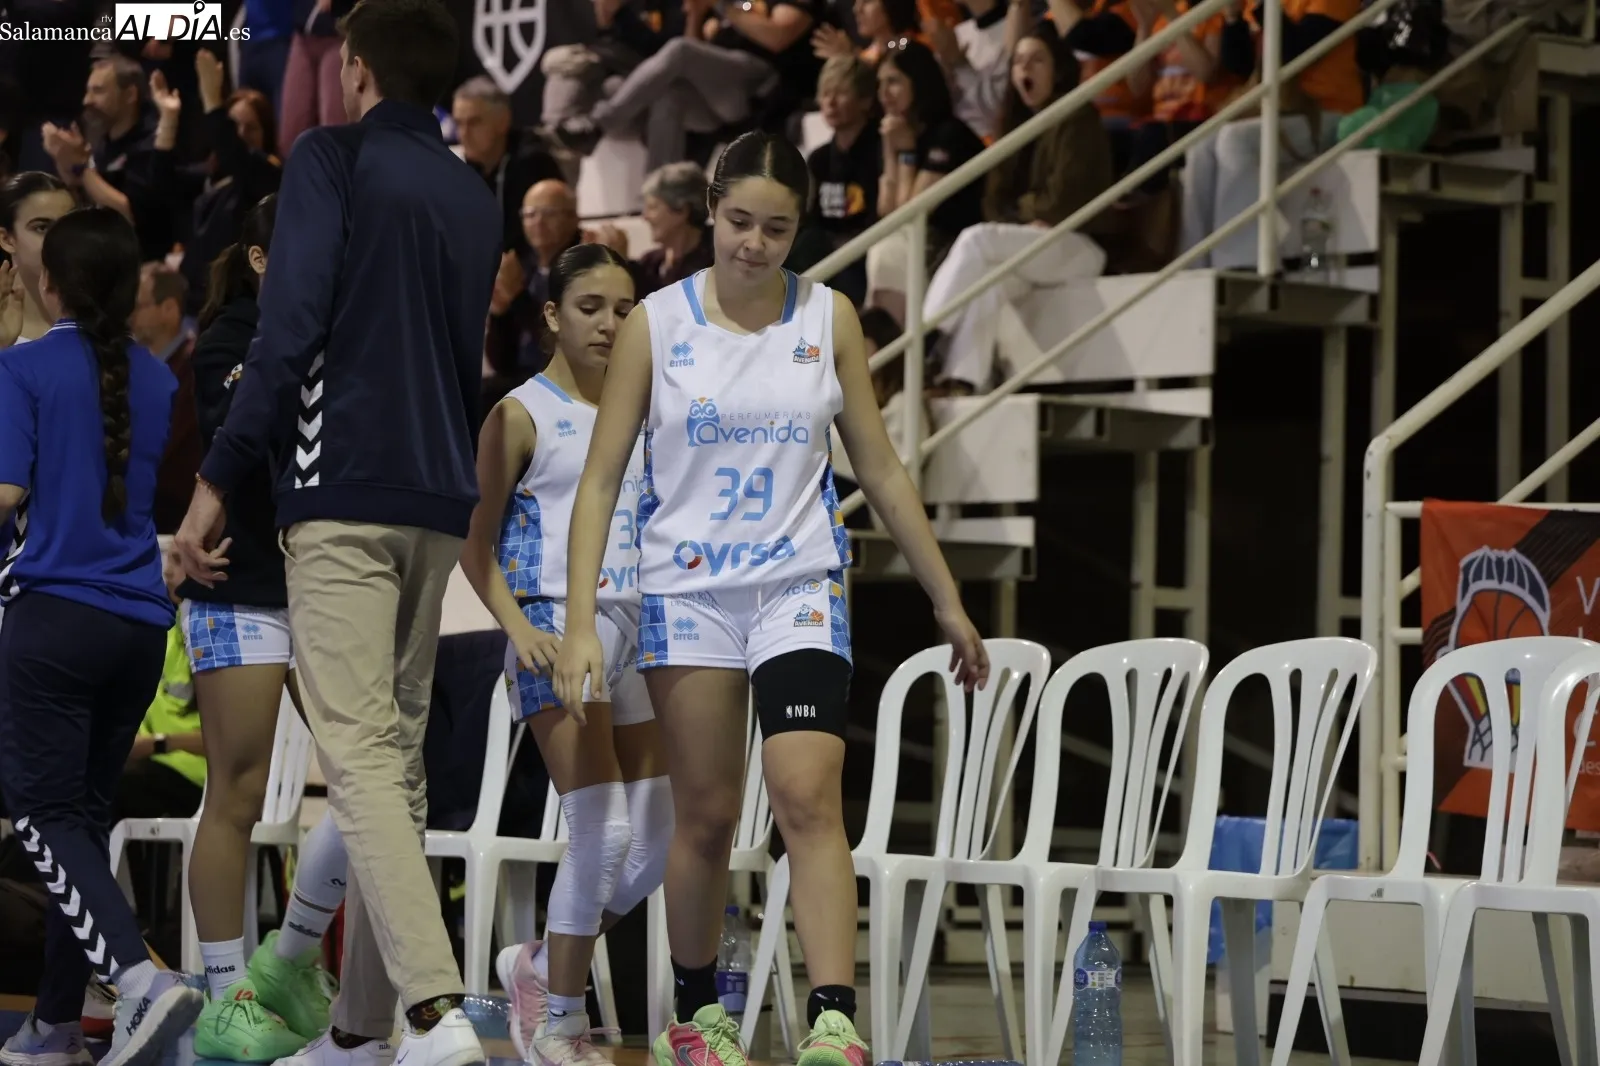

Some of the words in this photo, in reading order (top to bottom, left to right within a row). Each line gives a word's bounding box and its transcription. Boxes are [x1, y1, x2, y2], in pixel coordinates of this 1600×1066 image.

[669, 357, 695, 368] errea
[720, 410, 812, 421] PERFUMERÍAS
[696, 419, 809, 445] avenida
[709, 467, 774, 521] 39
[673, 632, 700, 641] errea
[794, 704, 817, 718] NBA
[125, 996, 152, 1037] HOKA
